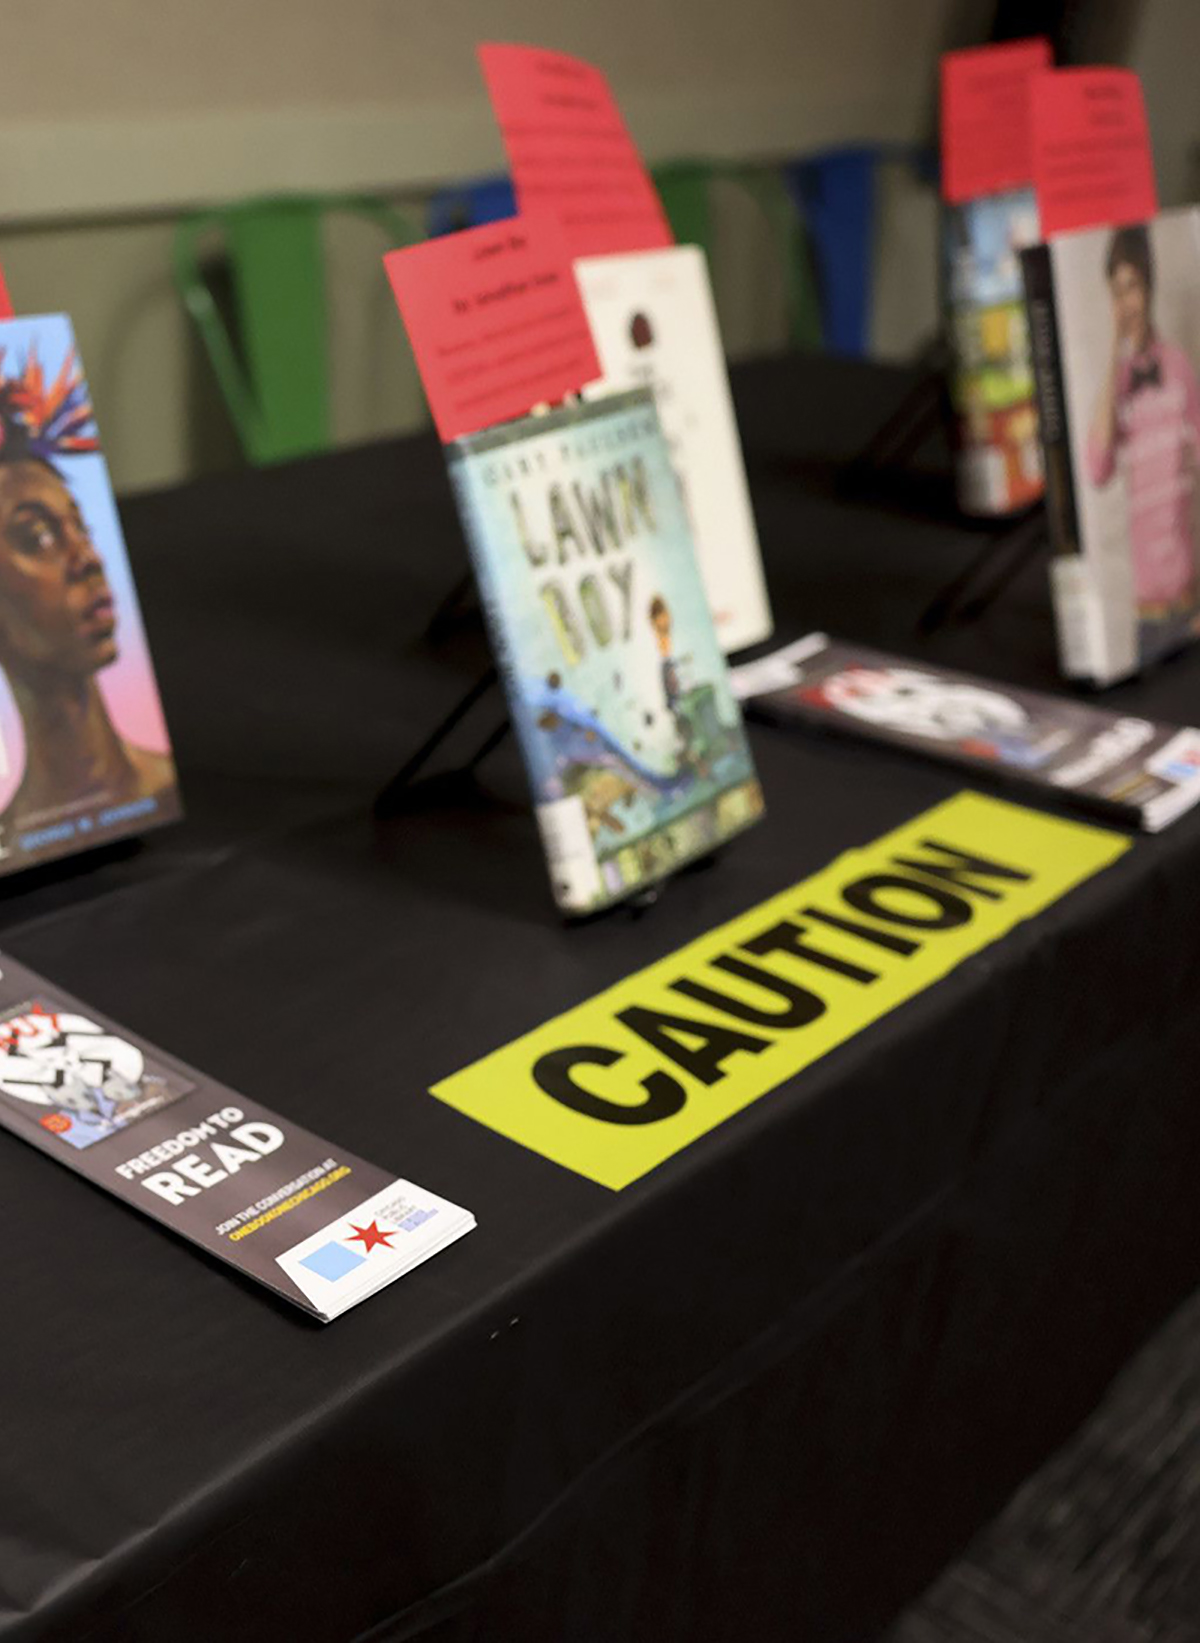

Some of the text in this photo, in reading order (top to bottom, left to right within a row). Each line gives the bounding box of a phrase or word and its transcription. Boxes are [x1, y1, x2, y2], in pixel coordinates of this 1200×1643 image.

[508, 454, 658, 570] LAWN
[531, 839, 1035, 1127] CAUTION
[114, 1122, 218, 1181] FREEDOM
[209, 1106, 245, 1131] TO
[140, 1121, 286, 1207] READ
[215, 1216, 242, 1236] JOIN
[234, 1204, 261, 1222] THE
[254, 1165, 327, 1211] CONVERSATION
